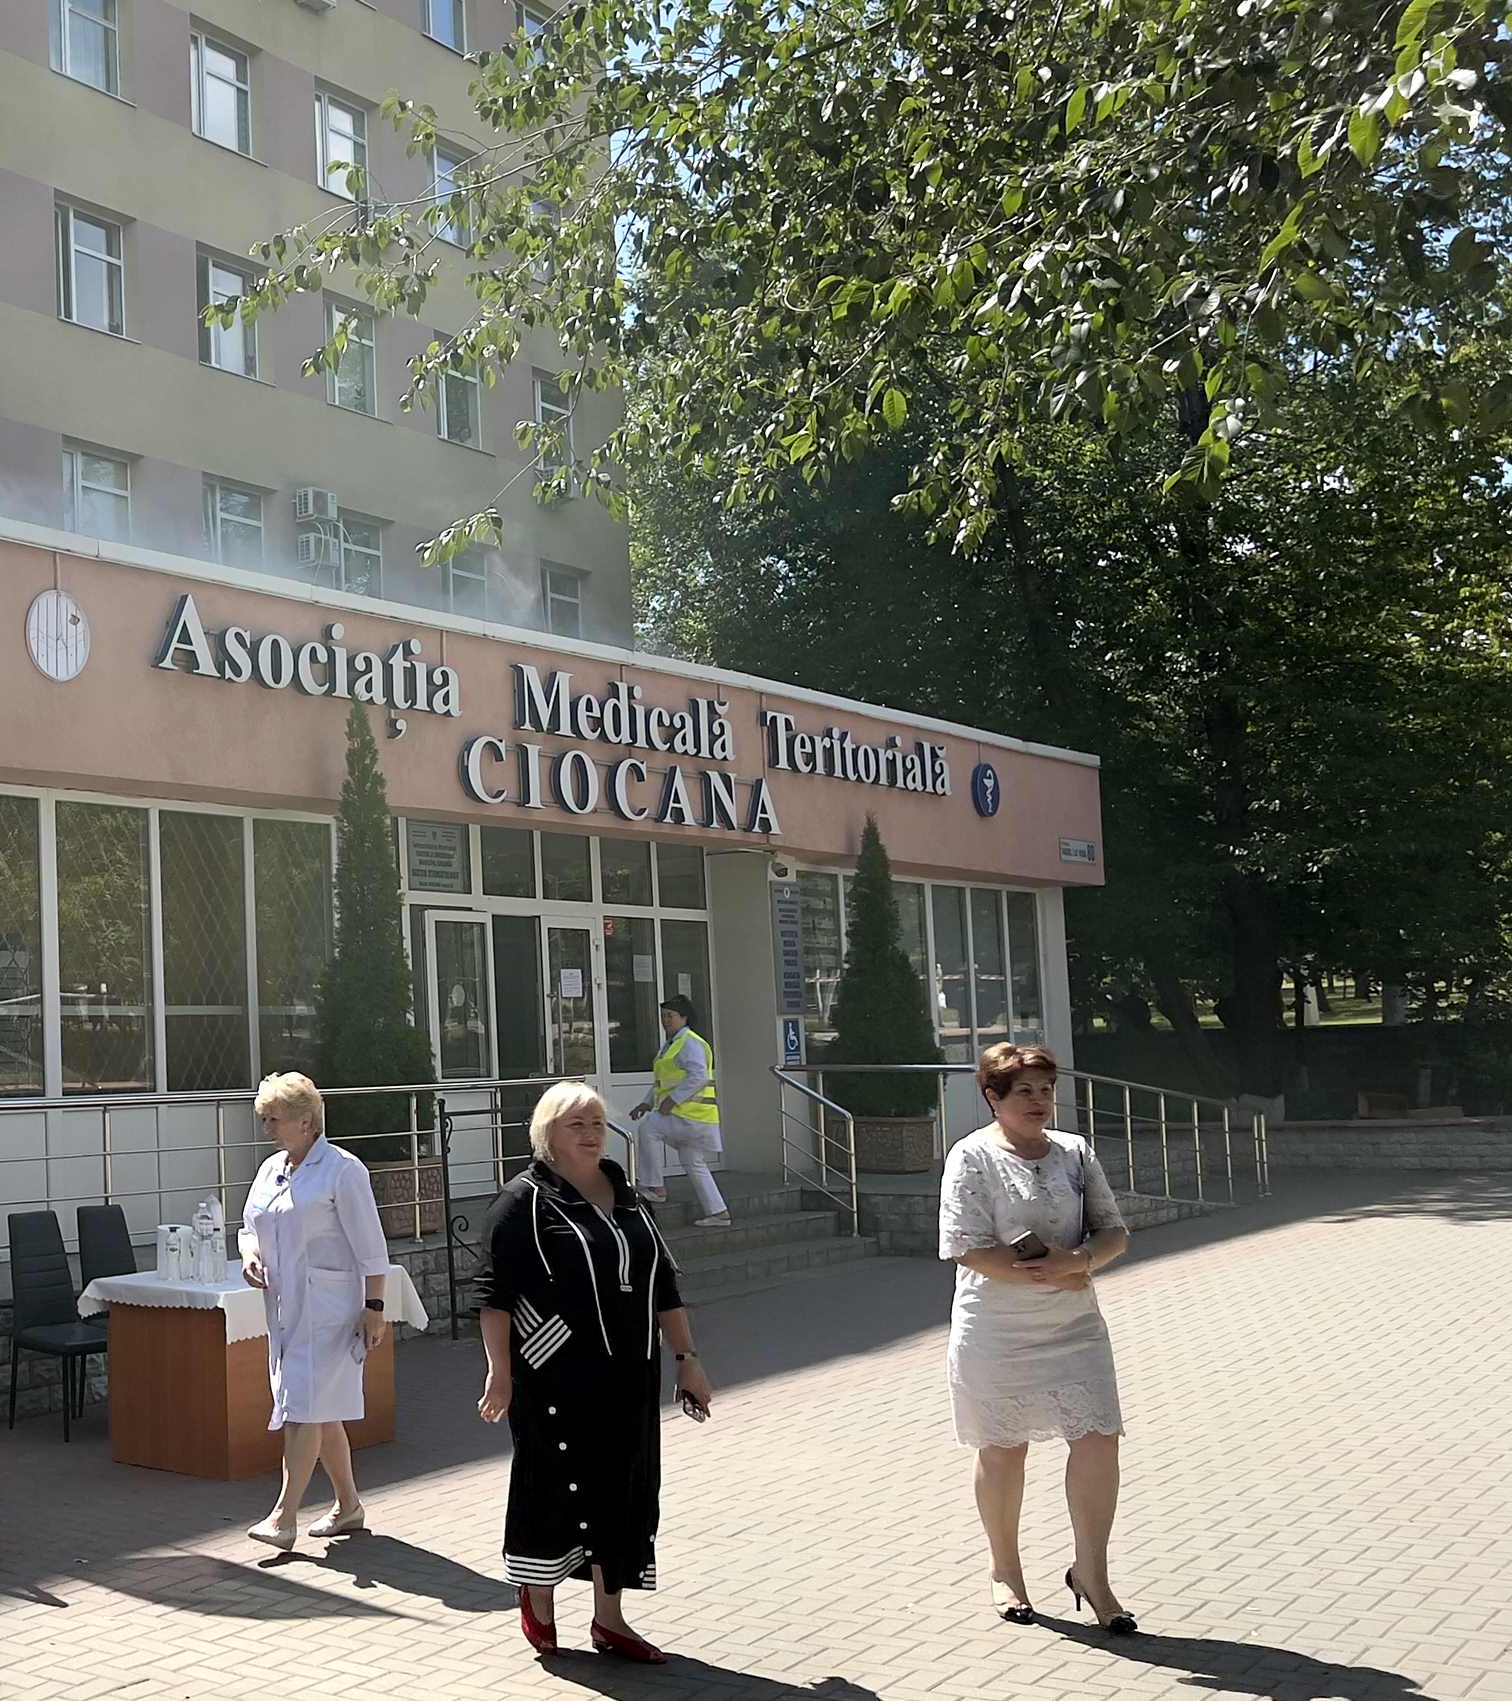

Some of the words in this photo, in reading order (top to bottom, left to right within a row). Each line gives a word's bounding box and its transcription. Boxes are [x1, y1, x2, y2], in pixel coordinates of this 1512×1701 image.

[154, 592, 463, 740] Asociația
[513, 663, 736, 762] Medicală
[762, 710, 953, 796] Teritorială
[463, 735, 783, 834] CIOCANA
